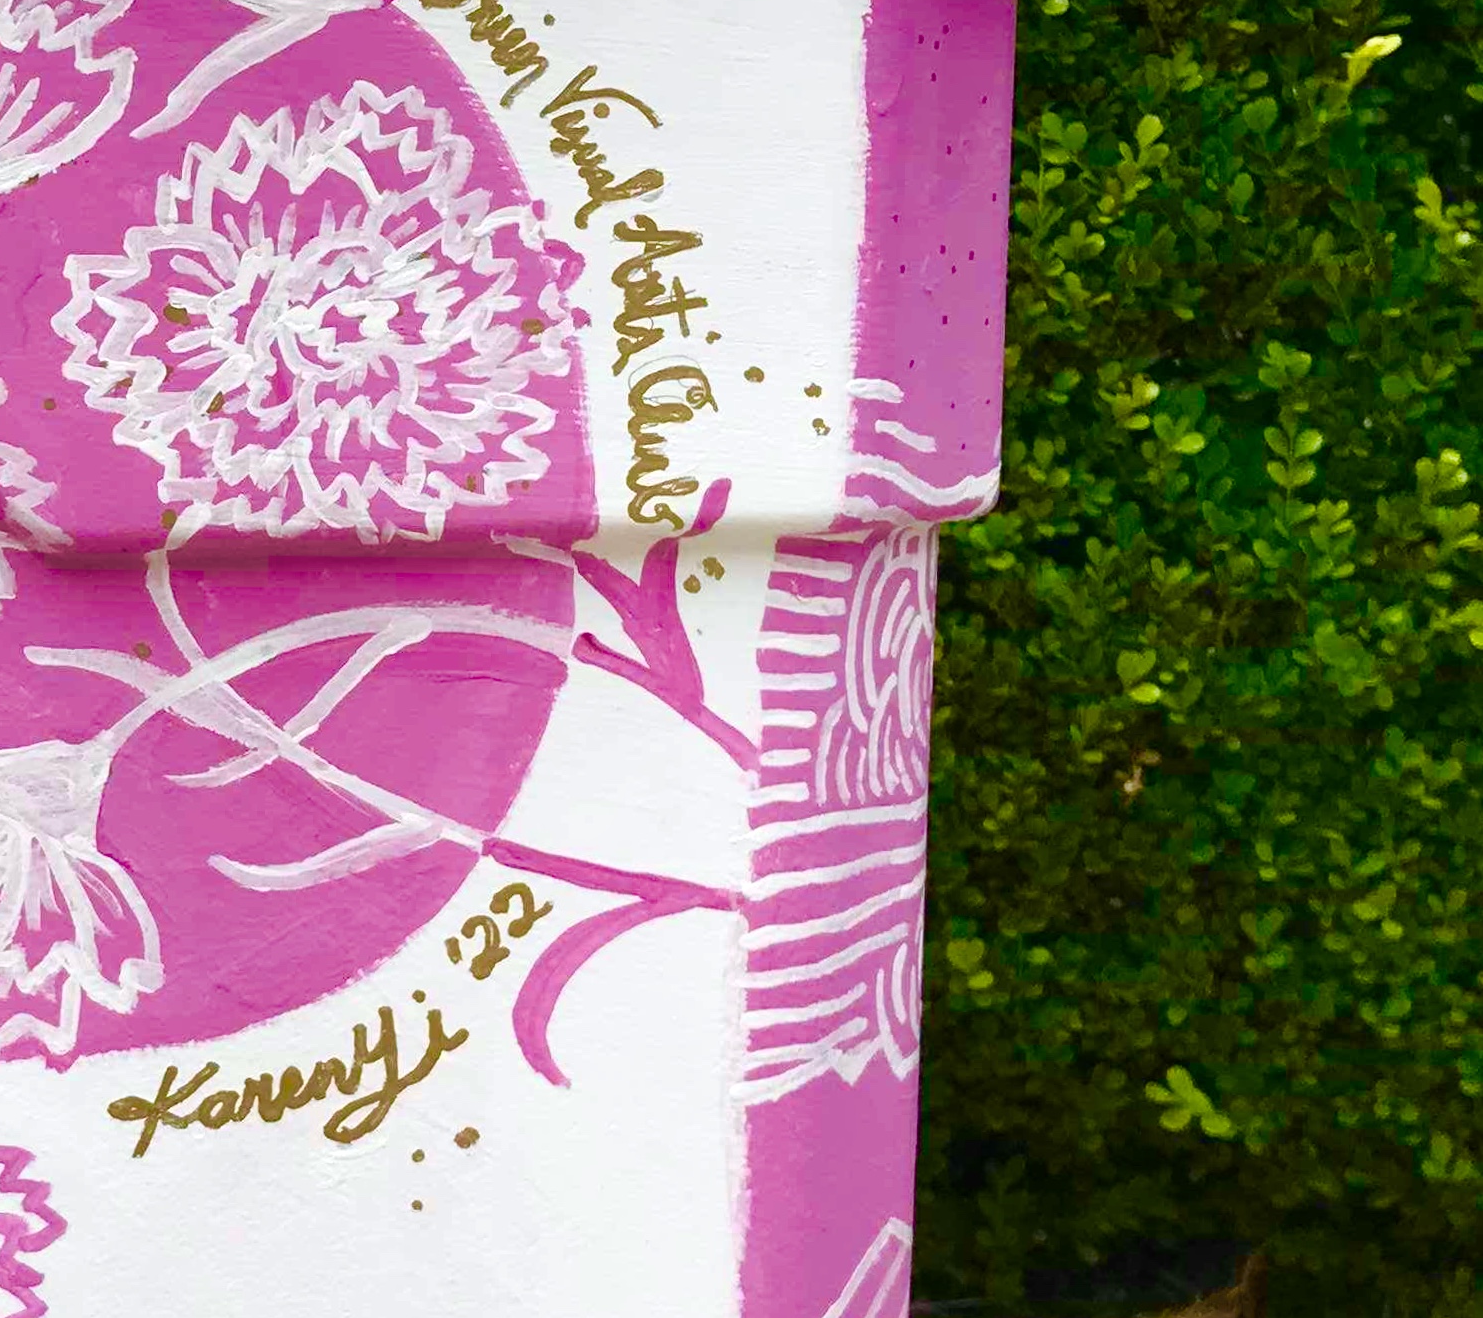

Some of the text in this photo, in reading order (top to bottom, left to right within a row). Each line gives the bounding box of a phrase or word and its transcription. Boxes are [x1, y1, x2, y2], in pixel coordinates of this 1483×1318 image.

[539, 65, 664, 230] Visual
[611, 213, 709, 377] Arts
[625, 364, 718, 531] Club
[444, 882, 554, 981] '22
